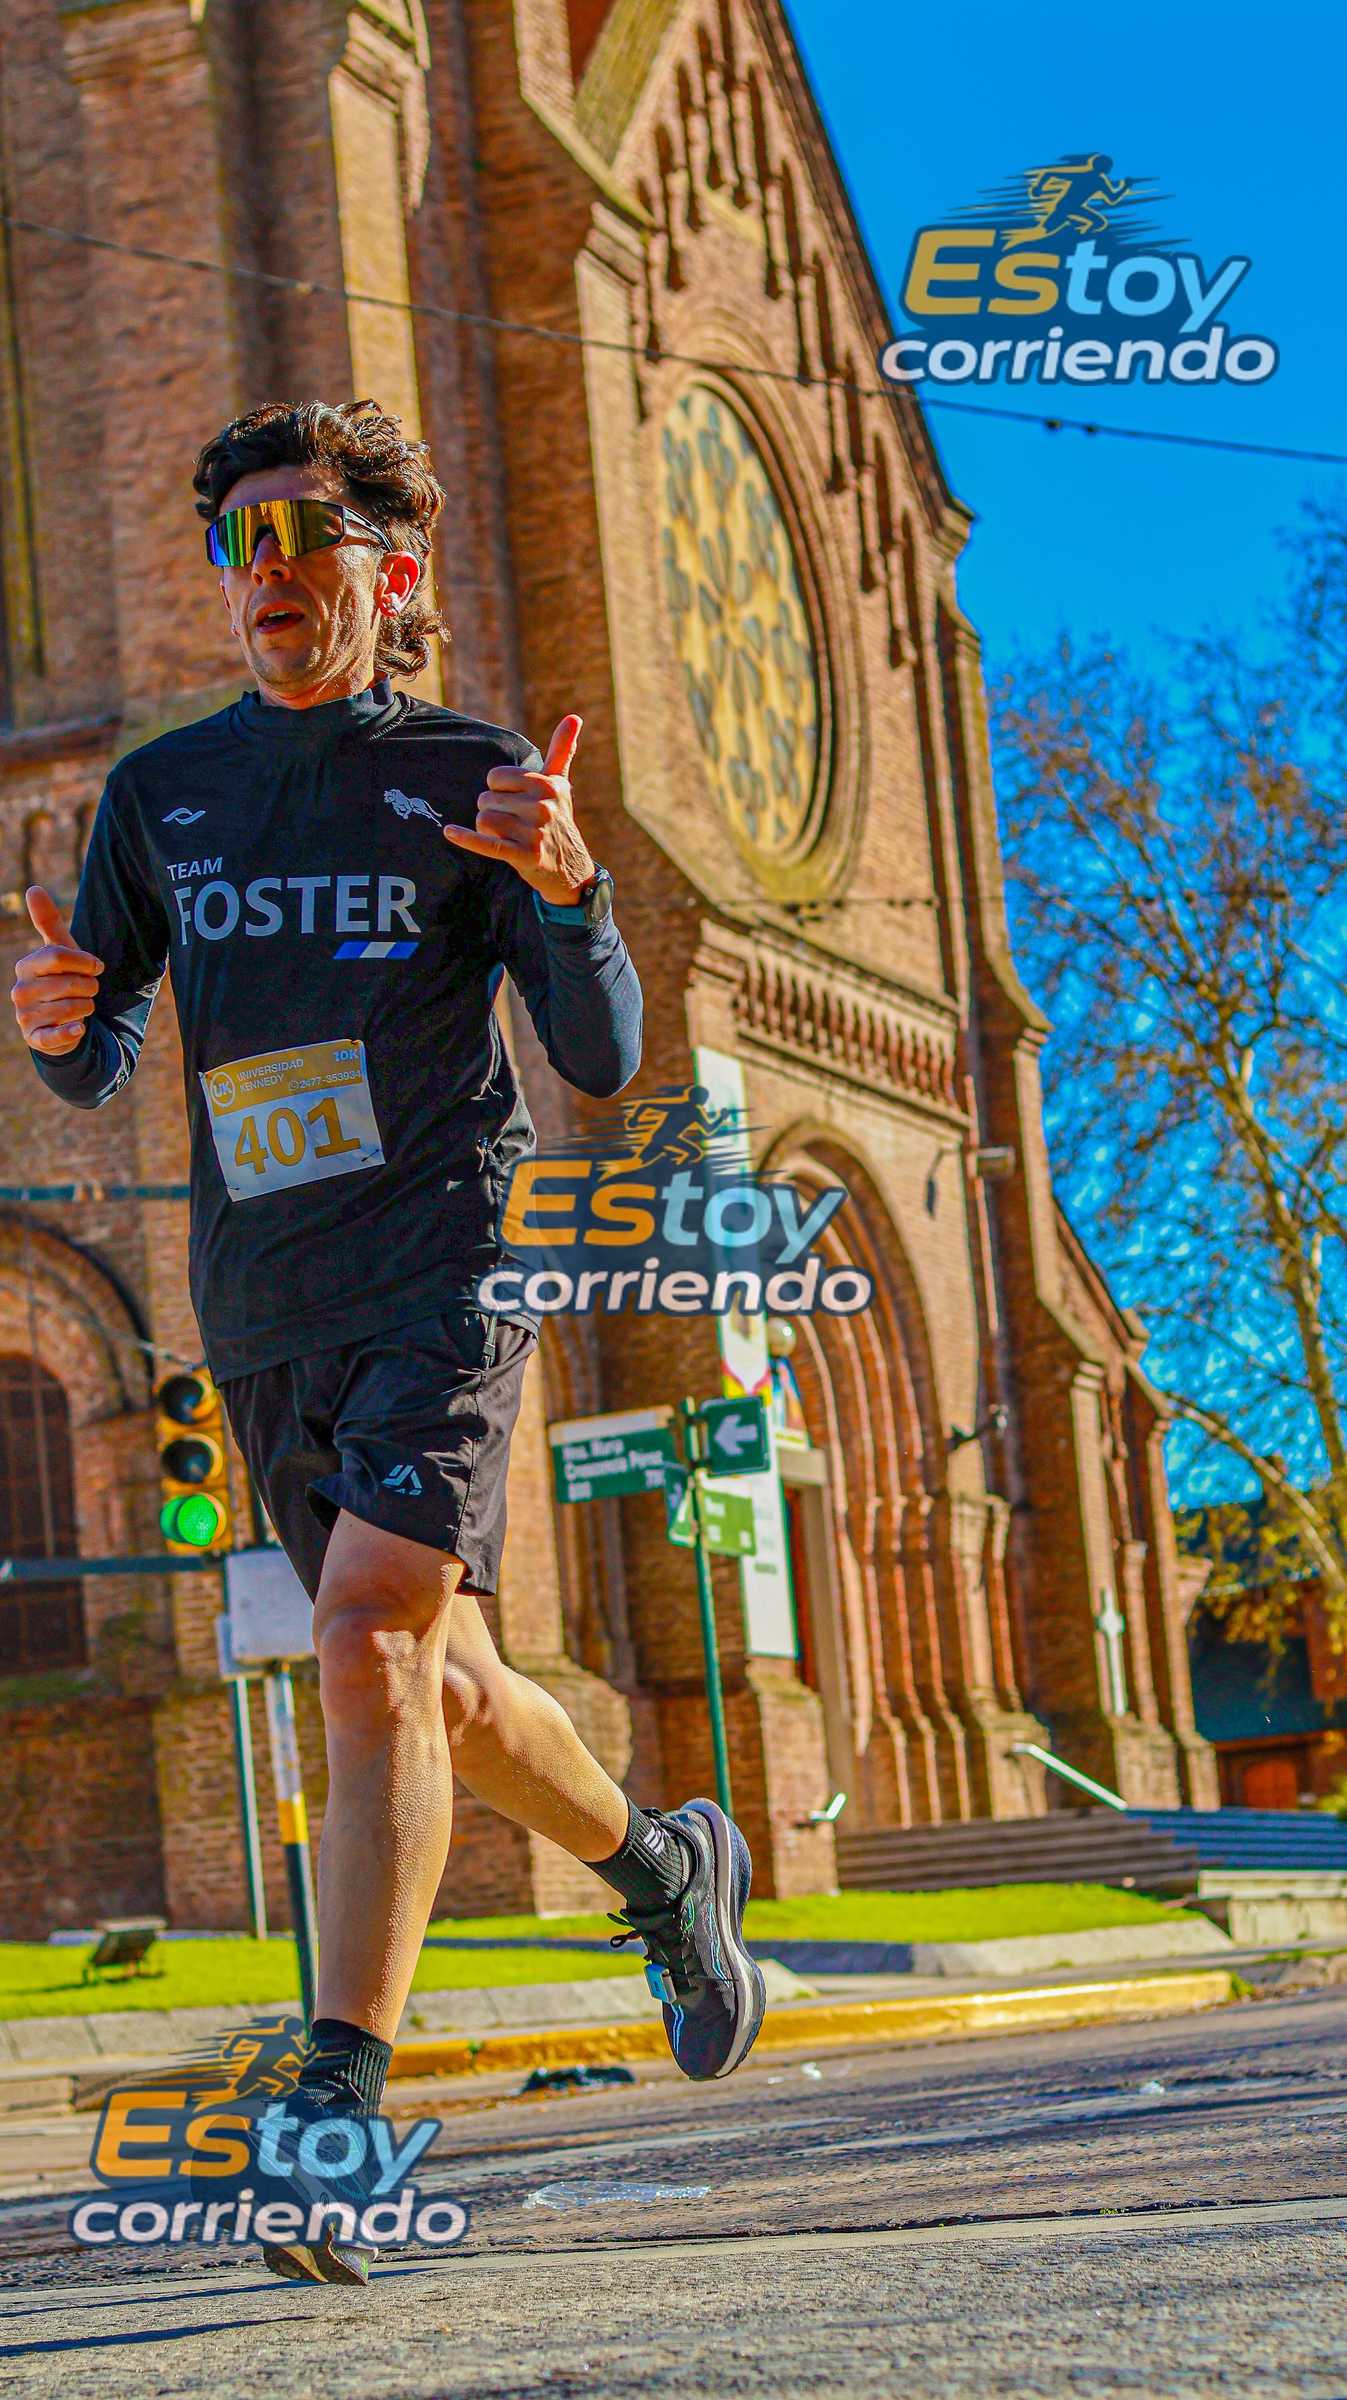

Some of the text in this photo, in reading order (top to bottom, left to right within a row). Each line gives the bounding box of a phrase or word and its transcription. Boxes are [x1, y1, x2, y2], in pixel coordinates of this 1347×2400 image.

[167, 856, 224, 881] TEAM
[174, 875, 422, 945] FOSTER
[237, 1058, 304, 1082] UNIVERSIDAD
[213, 1082, 233, 1098] UK
[239, 1073, 284, 1093] KENNEDY
[234, 1097, 361, 1175] 401
